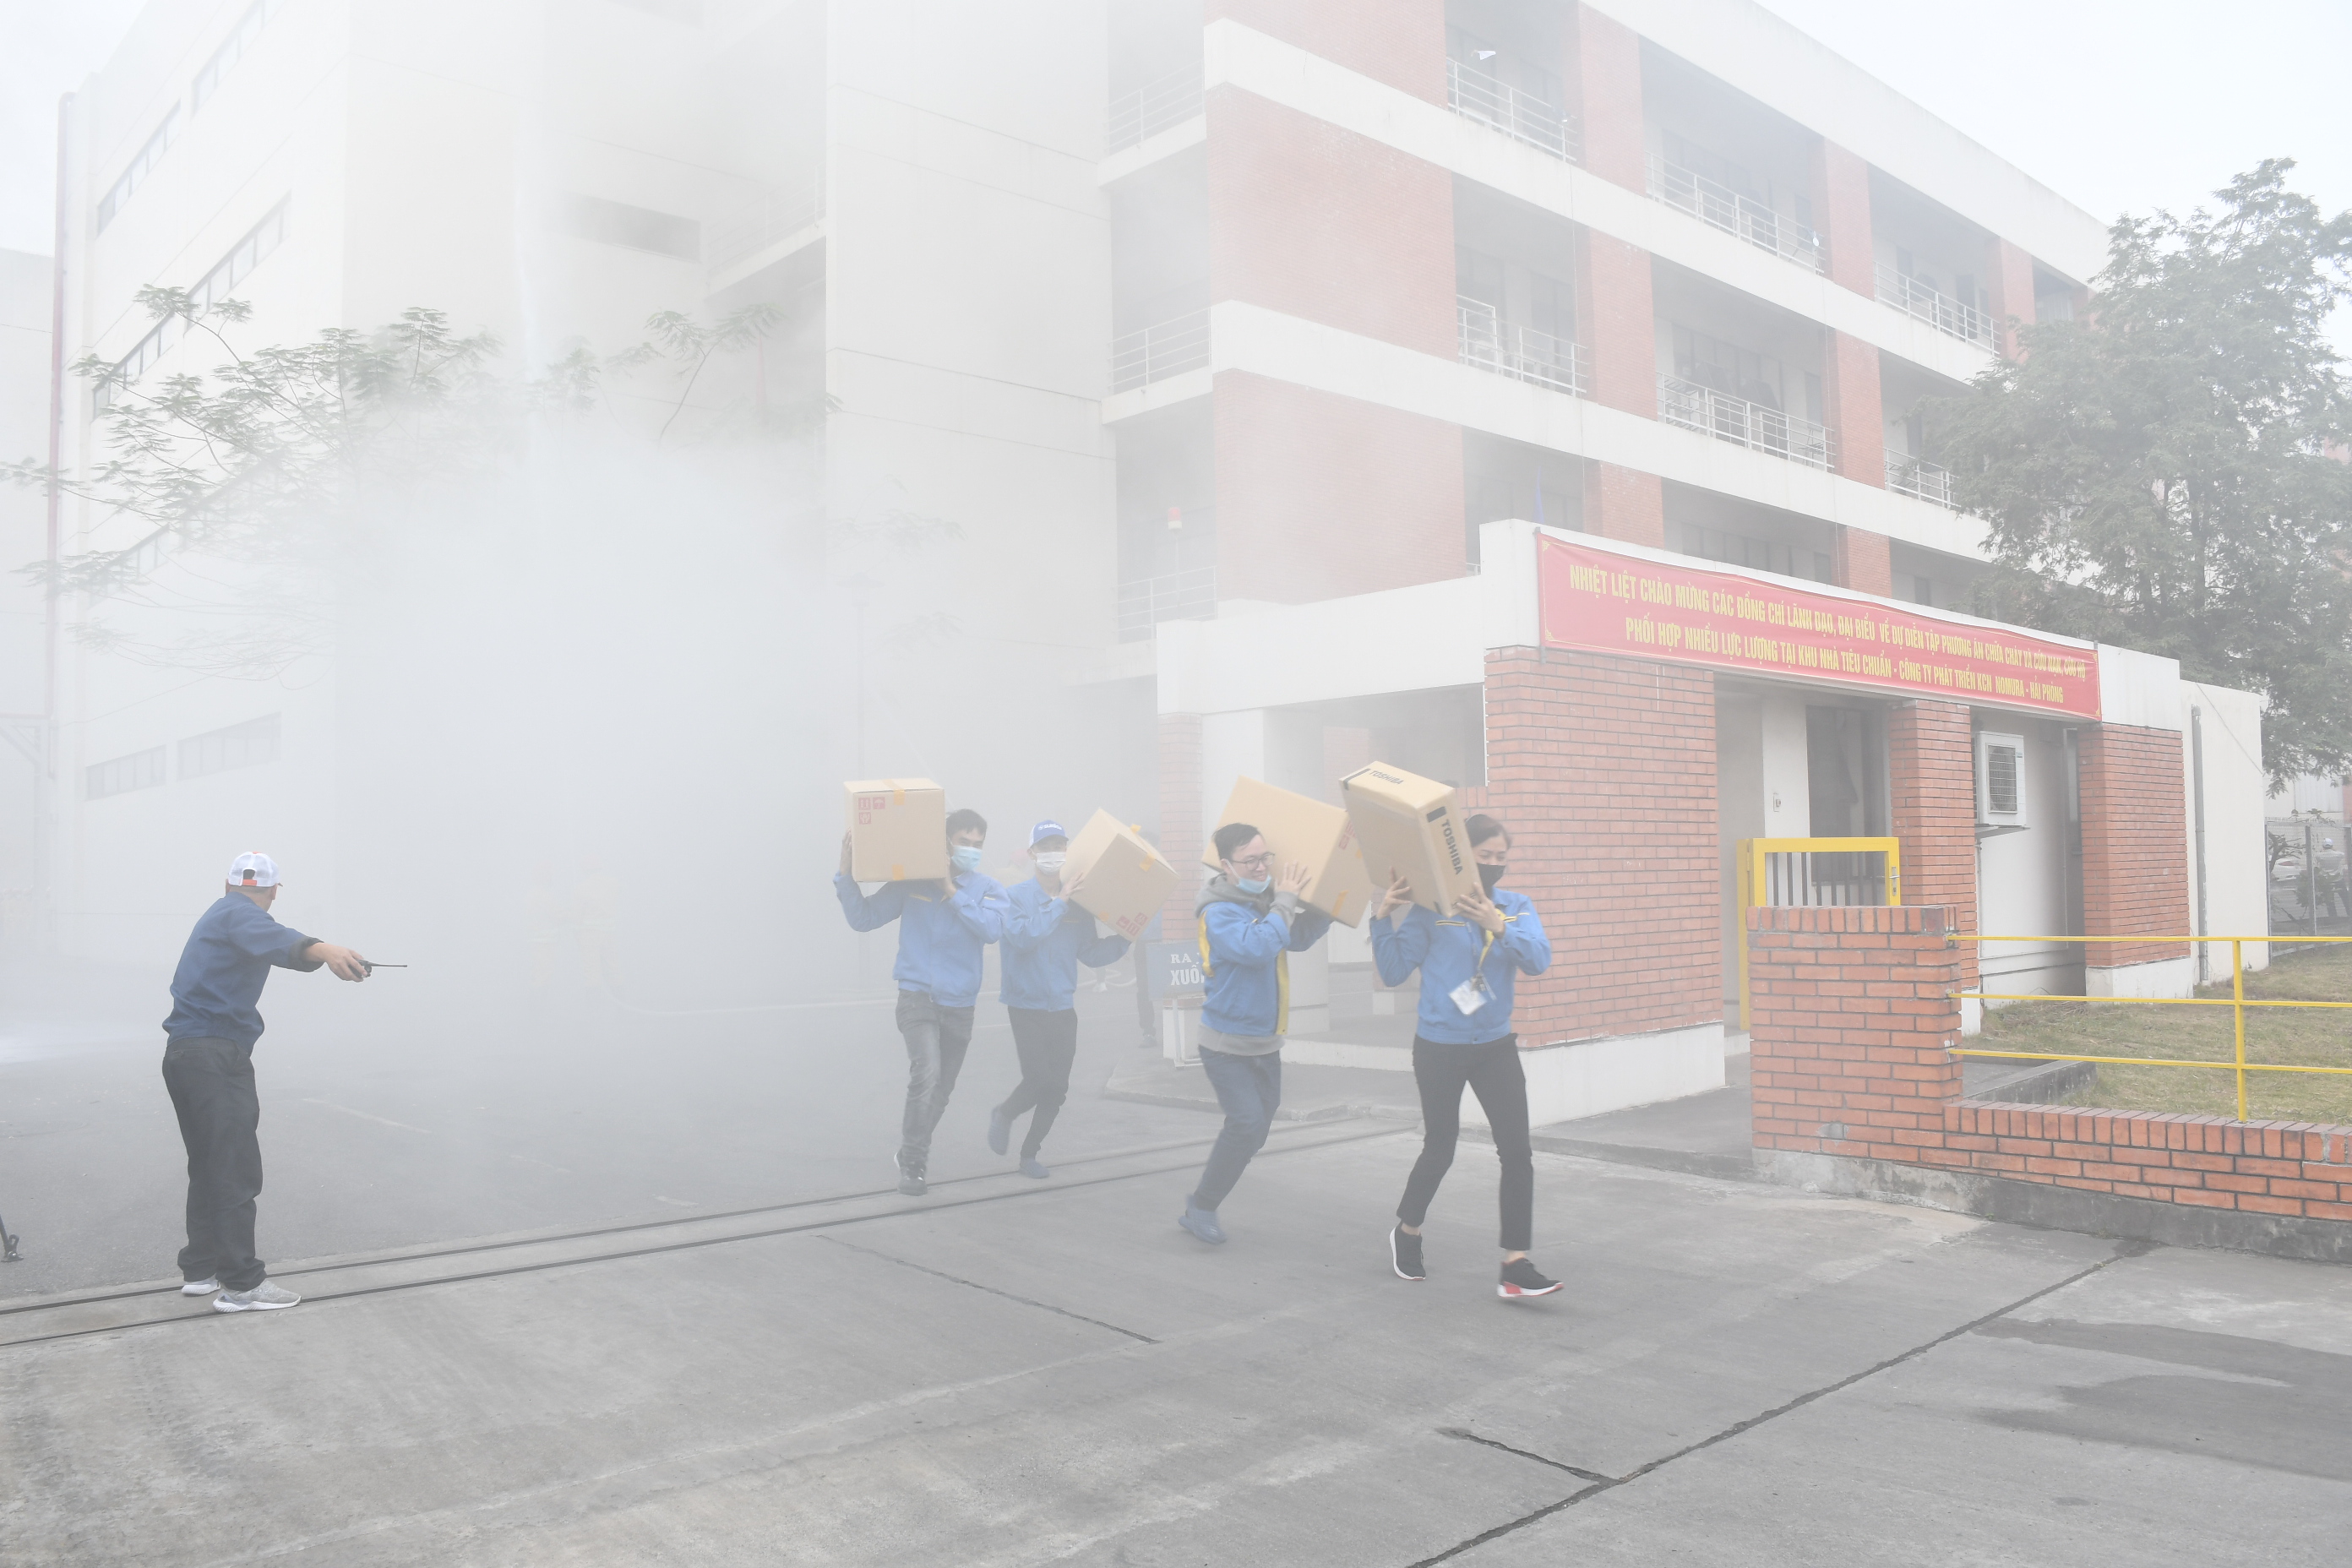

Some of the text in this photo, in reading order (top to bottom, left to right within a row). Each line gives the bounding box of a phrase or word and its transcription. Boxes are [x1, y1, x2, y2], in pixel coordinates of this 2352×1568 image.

[1570, 564, 1607, 599] NHIỆT
[1611, 569, 1636, 604] LIỆT
[1640, 576, 1673, 607] CHÀO
[1675, 581, 1710, 612] MỪNG
[1712, 588, 1734, 617] CÁC
[1737, 591, 1766, 622] ĐỒNG
[1767, 600, 1785, 626] CHÍ
[1787, 602, 1813, 630] LÃNH
[1814, 611, 1837, 637] ĐẠO,
[1838, 615, 1854, 641] ĐẠI
[1855, 612, 1876, 641] BIỂU
[1879, 617, 1891, 644] VỀ
[1892, 625, 1903, 651] DỰ
[1905, 622, 1925, 650] DIỄN
[1925, 629, 1940, 656] TẬP
[1941, 635, 1972, 658] PHƯƠNG
[1974, 637, 1984, 661] ÁN
[1985, 640, 2004, 664] CHỮA
[2005, 645, 2023, 667] CHÁY
[2023, 648, 2033, 669] VÀ
[2034, 649, 2047, 672] CỨU
[1625, 612, 1655, 645] PHỐI
[1658, 622, 1681, 652] HỢP
[1685, 622, 1718, 654] NHIỀU
[1722, 632, 1742, 661] LỰC
[1744, 635, 1778, 665] LƯỢNG
[1780, 640, 1796, 669] TẠI
[1798, 644, 1818, 668] KHU
[1820, 645, 1840, 671] NHÀ
[1840, 648, 1860, 673] TIÊU
[1862, 649, 1892, 678] CHUẨN
[1899, 657, 1921, 683] CÔNG
[1923, 664, 1931, 684] TY
[1934, 664, 1953, 687] PHÁT
[1954, 664, 1976, 690] TRIỂN
[1977, 672, 1992, 693] KCN
[1995, 676, 2025, 698] NOMURA
[2029, 675, 2041, 700] HẢI
[2042, 681, 2064, 704] PHÒNG
[1370, 770, 1403, 785] TOSHIBA
[1442, 819, 1463, 875] TOSHIBA
[1170, 953, 1192, 963] RA
